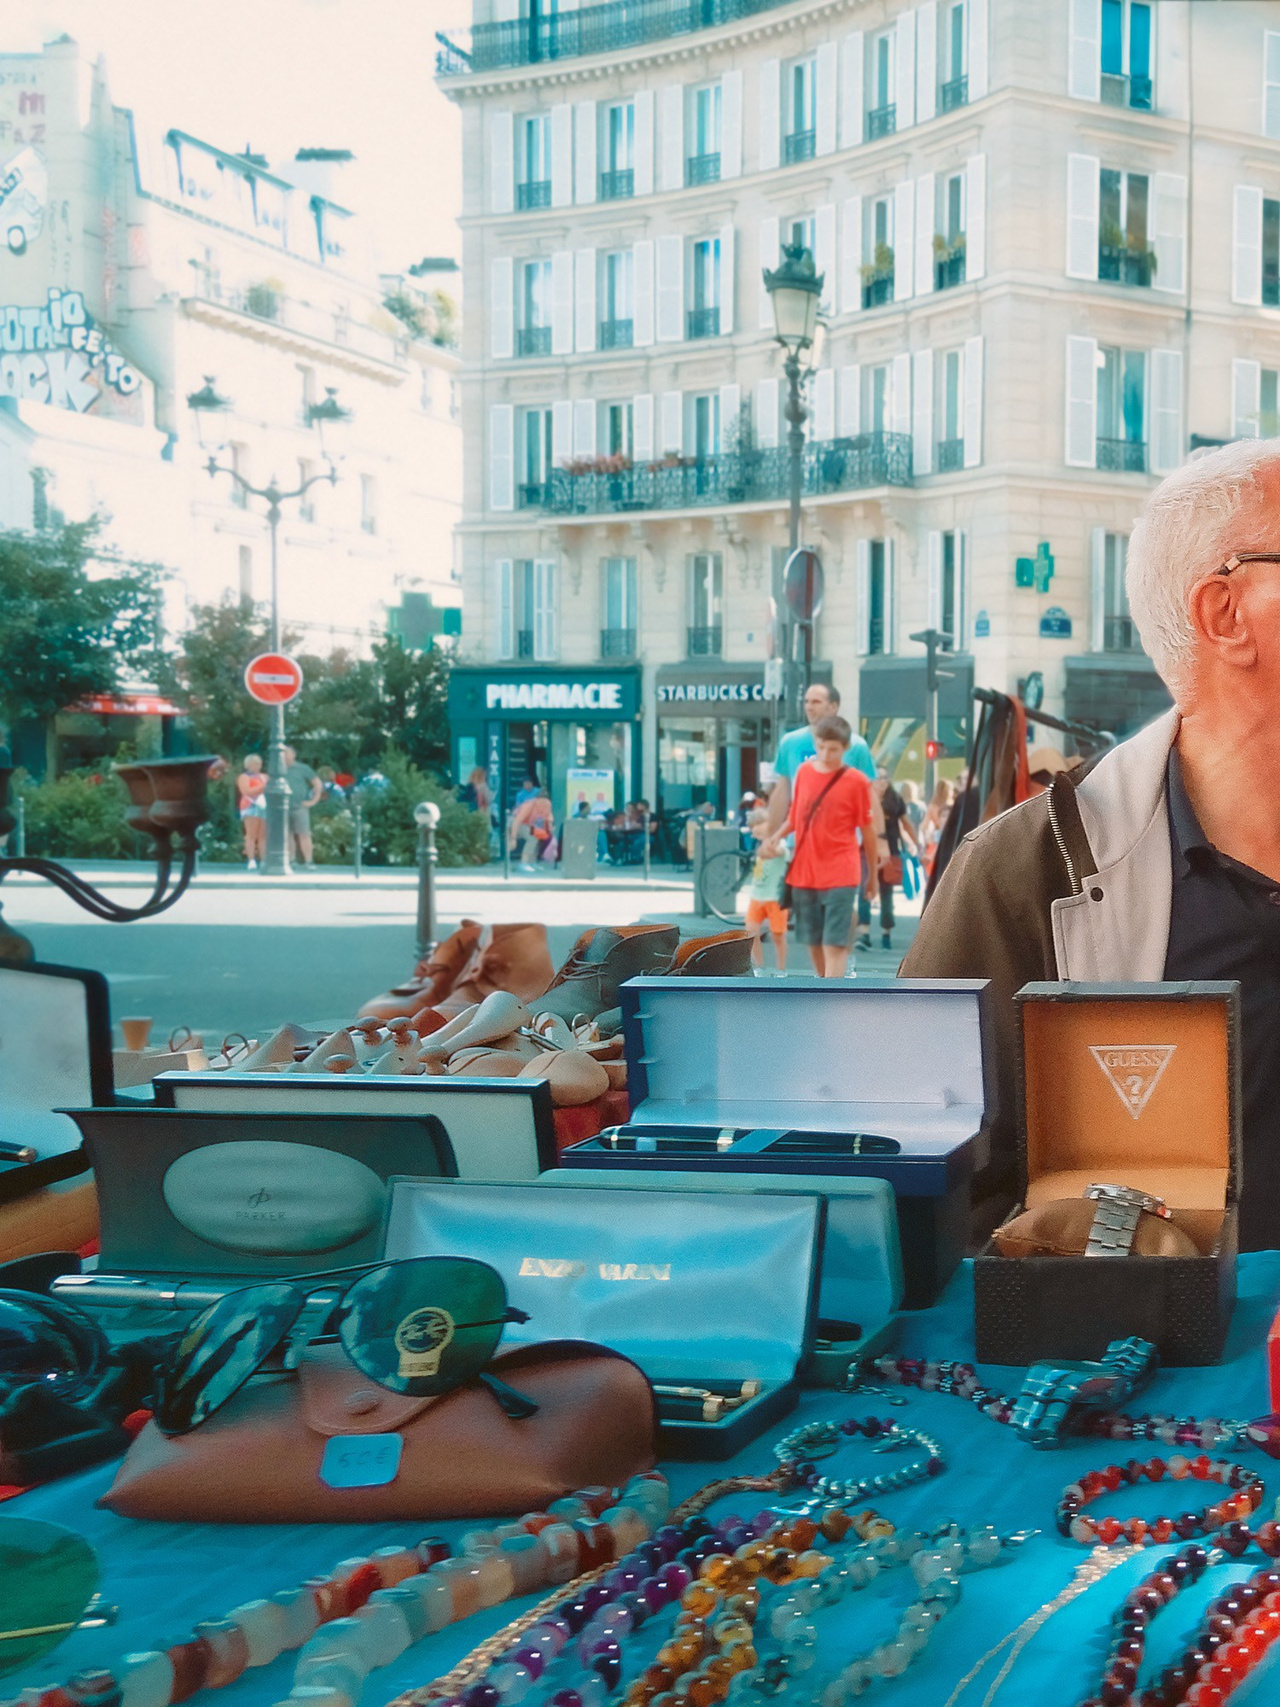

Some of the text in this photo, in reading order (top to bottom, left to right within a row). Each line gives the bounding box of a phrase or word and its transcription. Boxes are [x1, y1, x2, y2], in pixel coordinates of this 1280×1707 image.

[486, 683, 623, 709] PHARMACIE
[657, 684, 749, 701] STARBUCKS
[1103, 1051, 1163, 1067] GUESS
[235, 1211, 287, 1221] PARKER
